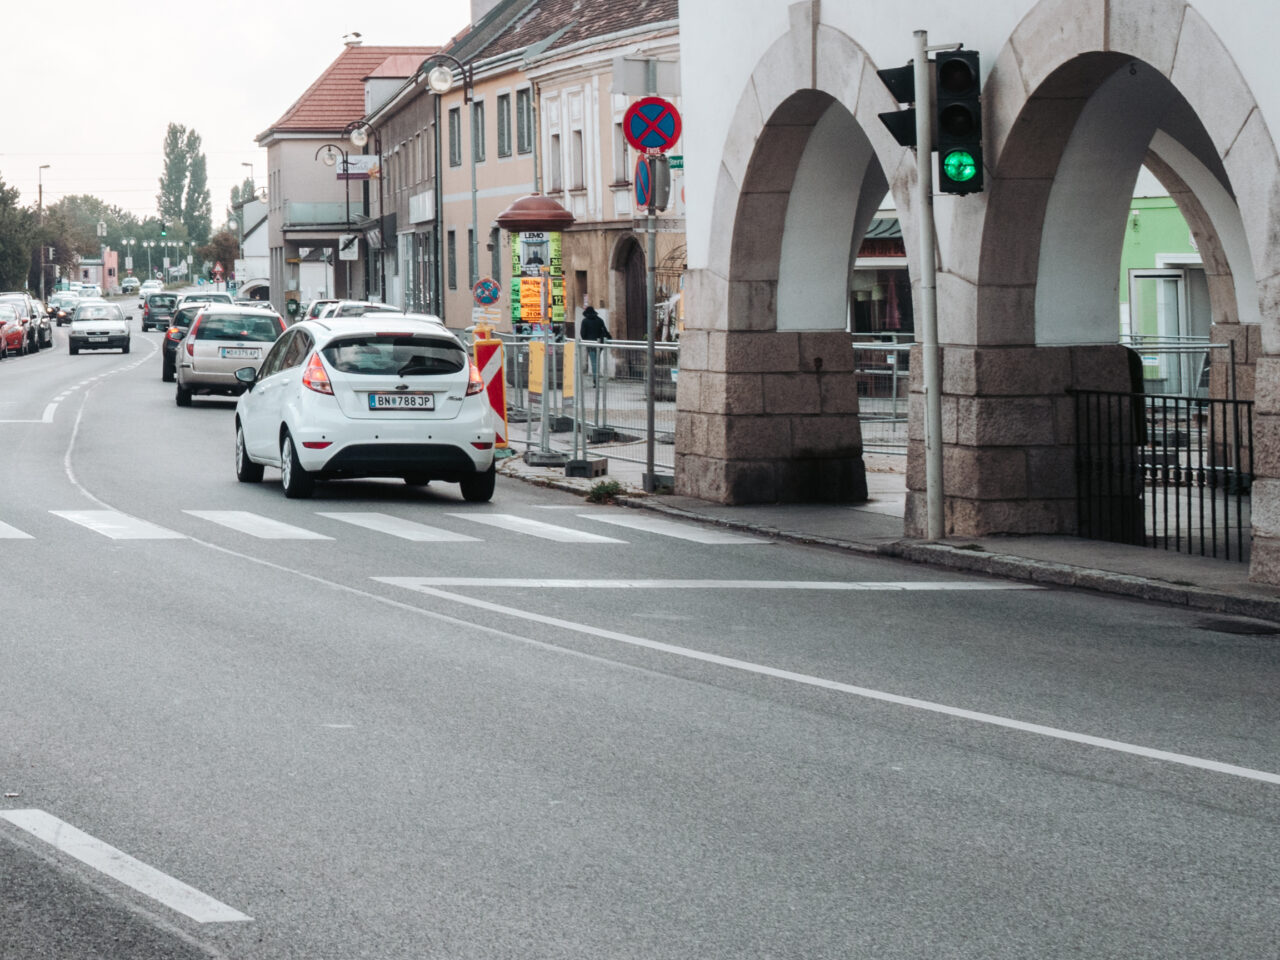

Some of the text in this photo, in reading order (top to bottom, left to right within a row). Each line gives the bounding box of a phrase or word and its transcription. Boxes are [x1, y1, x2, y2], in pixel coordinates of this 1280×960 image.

[378, 396, 430, 407] BN 788 JP
